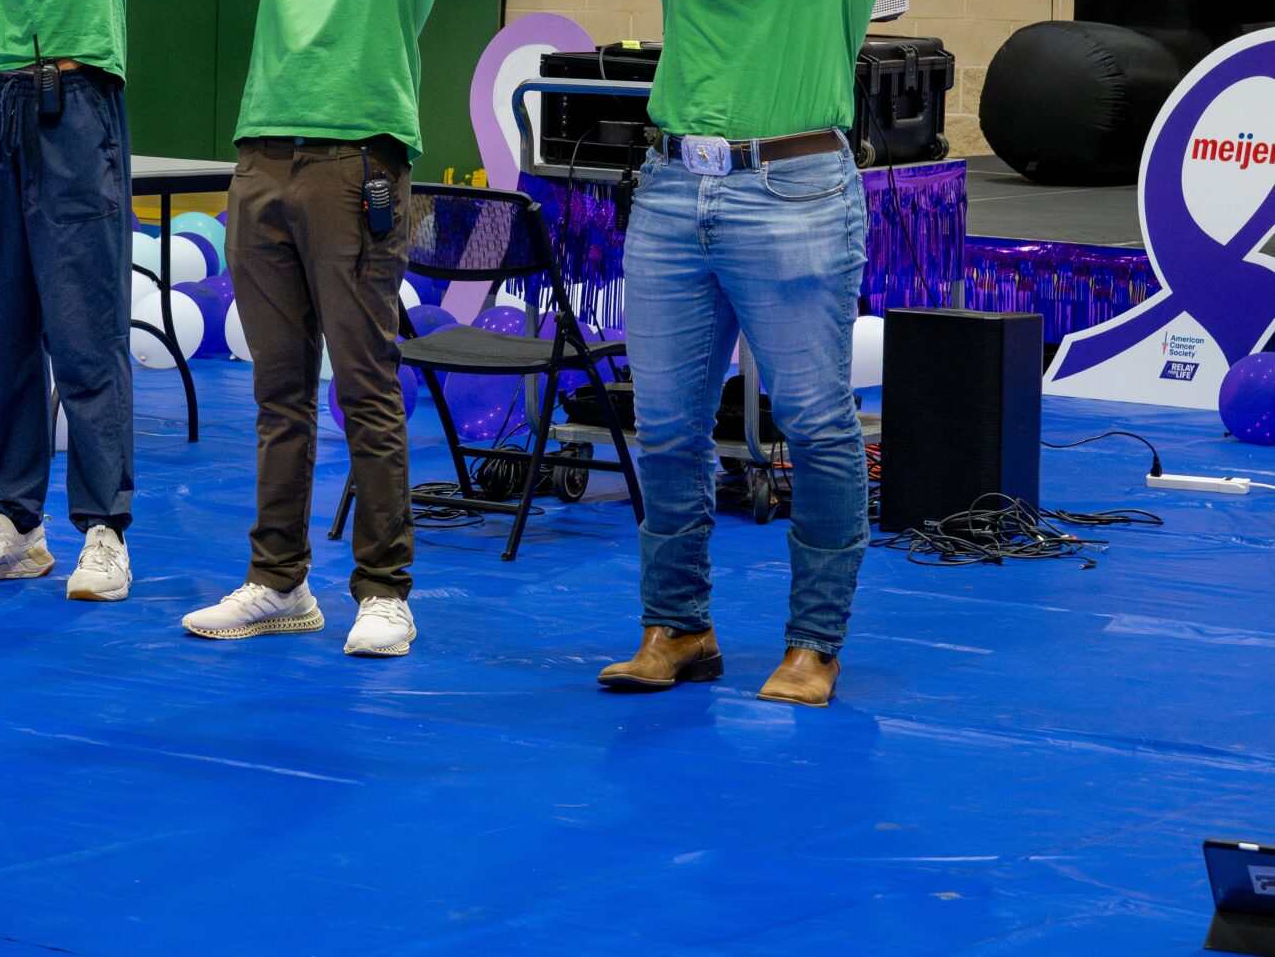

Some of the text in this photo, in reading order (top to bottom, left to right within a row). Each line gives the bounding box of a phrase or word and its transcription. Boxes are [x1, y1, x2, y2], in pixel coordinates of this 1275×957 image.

[1170, 335, 1204, 344] American
[1169, 342, 1196, 350] Cancer
[1169, 349, 1196, 359] Society
[1172, 363, 1196, 371] RELAY
[1175, 371, 1191, 379] LIFE
